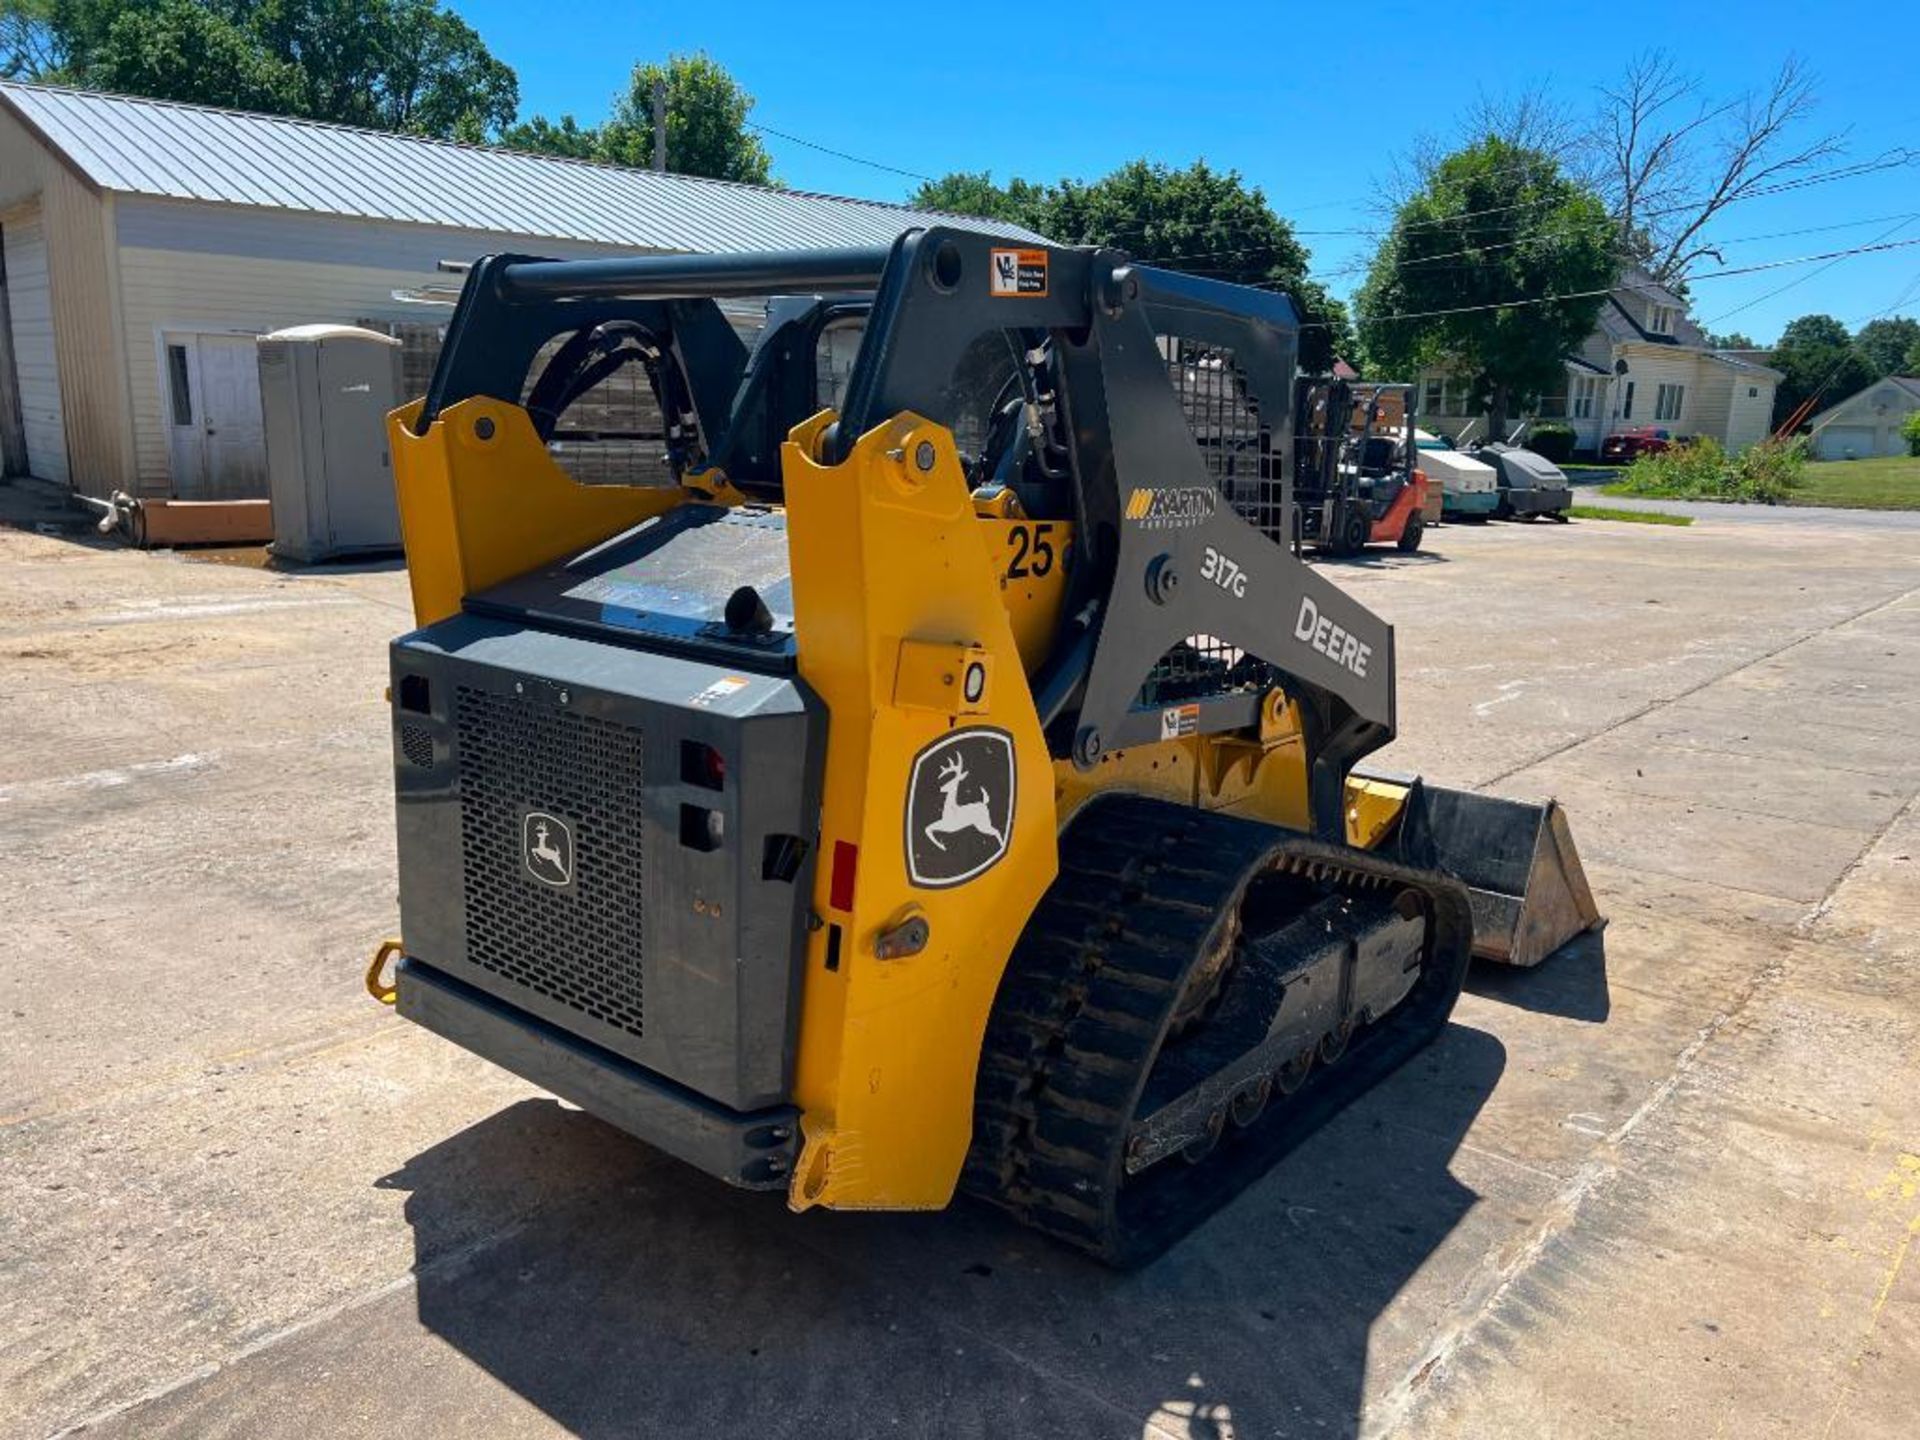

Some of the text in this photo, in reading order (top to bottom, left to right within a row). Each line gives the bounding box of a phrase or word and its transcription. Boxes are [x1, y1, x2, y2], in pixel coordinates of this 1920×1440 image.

[1007, 524, 1053, 578] 25
[1200, 547, 1247, 598] 317G
[1294, 596, 1372, 678] DEERE
